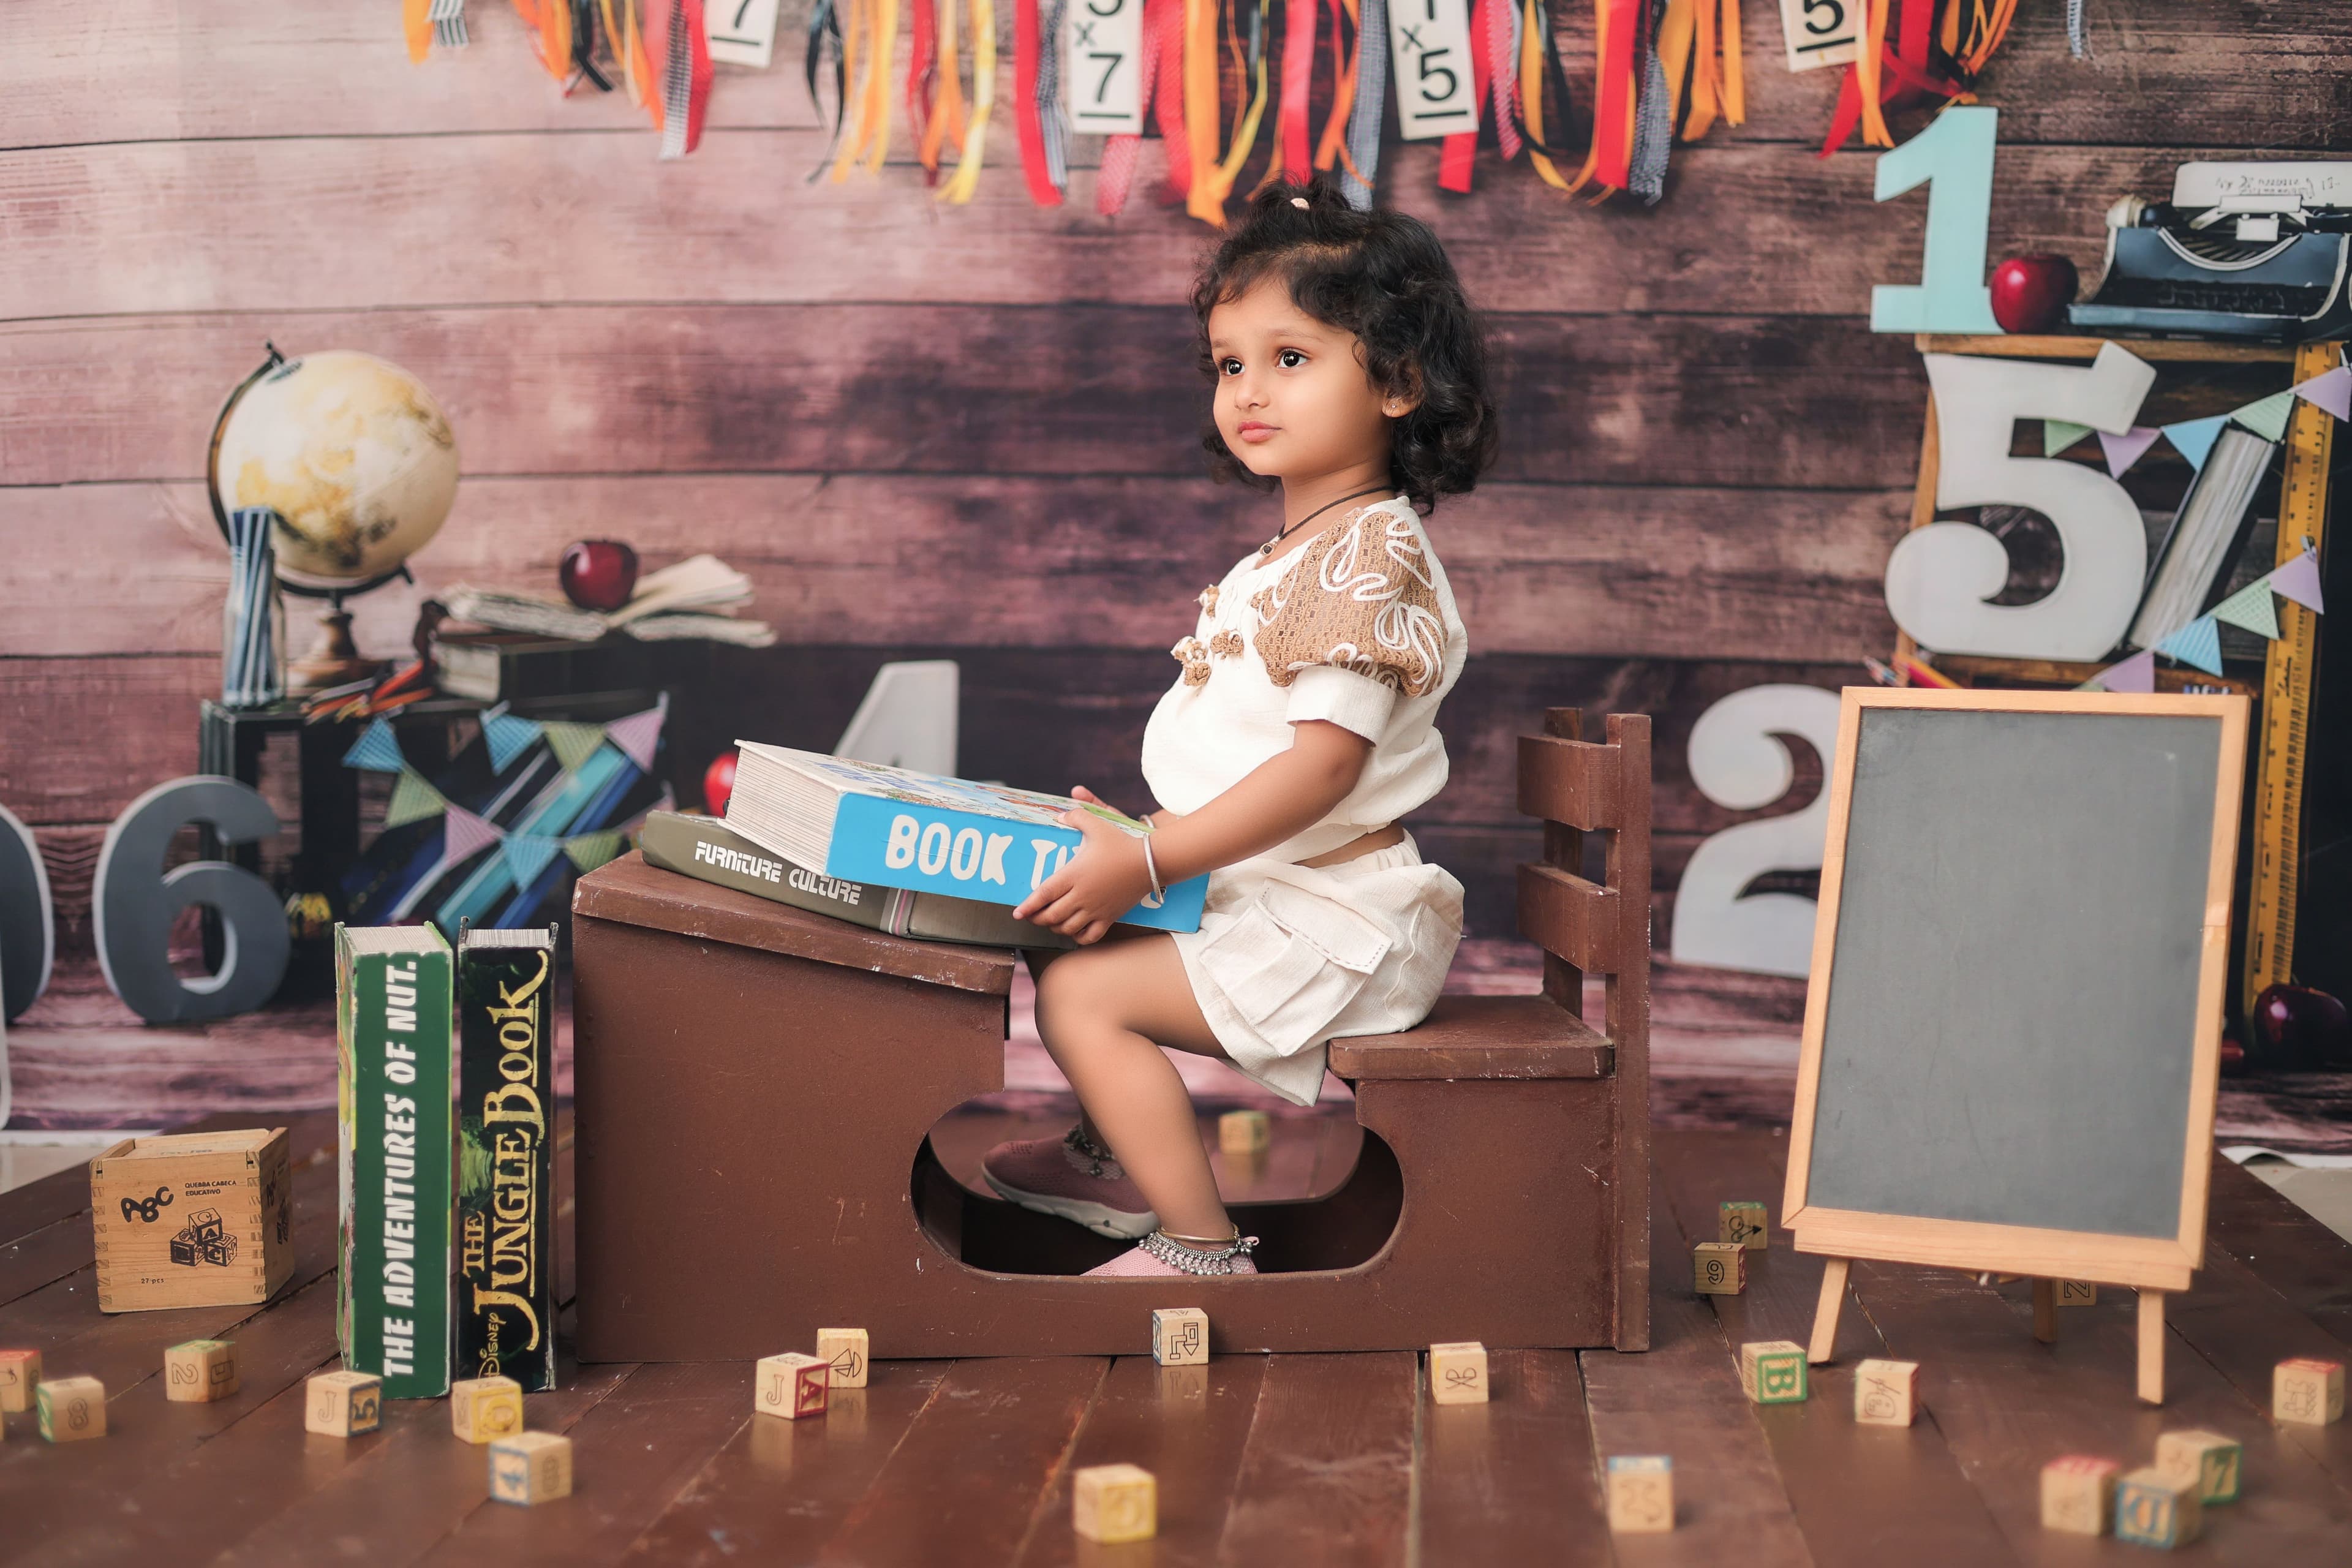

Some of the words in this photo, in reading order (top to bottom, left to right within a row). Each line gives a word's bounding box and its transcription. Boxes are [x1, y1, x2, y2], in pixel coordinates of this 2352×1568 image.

[1088, 53, 1122, 102] 7
[1420, 48, 1457, 101] 5
[1870, 105, 2000, 334] 1
[1885, 339, 2157, 662] 5
[885, 815, 1013, 886] BOOK
[1672, 684, 1841, 978] 2
[92, 774, 292, 1025] 6
[695, 840, 783, 883] FURNITURE
[788, 868, 862, 906] CULTURE
[385, 960, 417, 1031] NUT.
[384, 1041, 416, 1084] OF
[483, 949, 549, 1148] BOOK
[121, 1186, 174, 1223] ABC
[383, 1092, 417, 1308] ADVENTURES
[462, 1210, 486, 1278] THE
[473, 1128, 540, 1351] JUNGLE
[382, 1317, 415, 1378] THE
[317, 1390, 337, 1422] J
[766, 1373, 785, 1406] J
